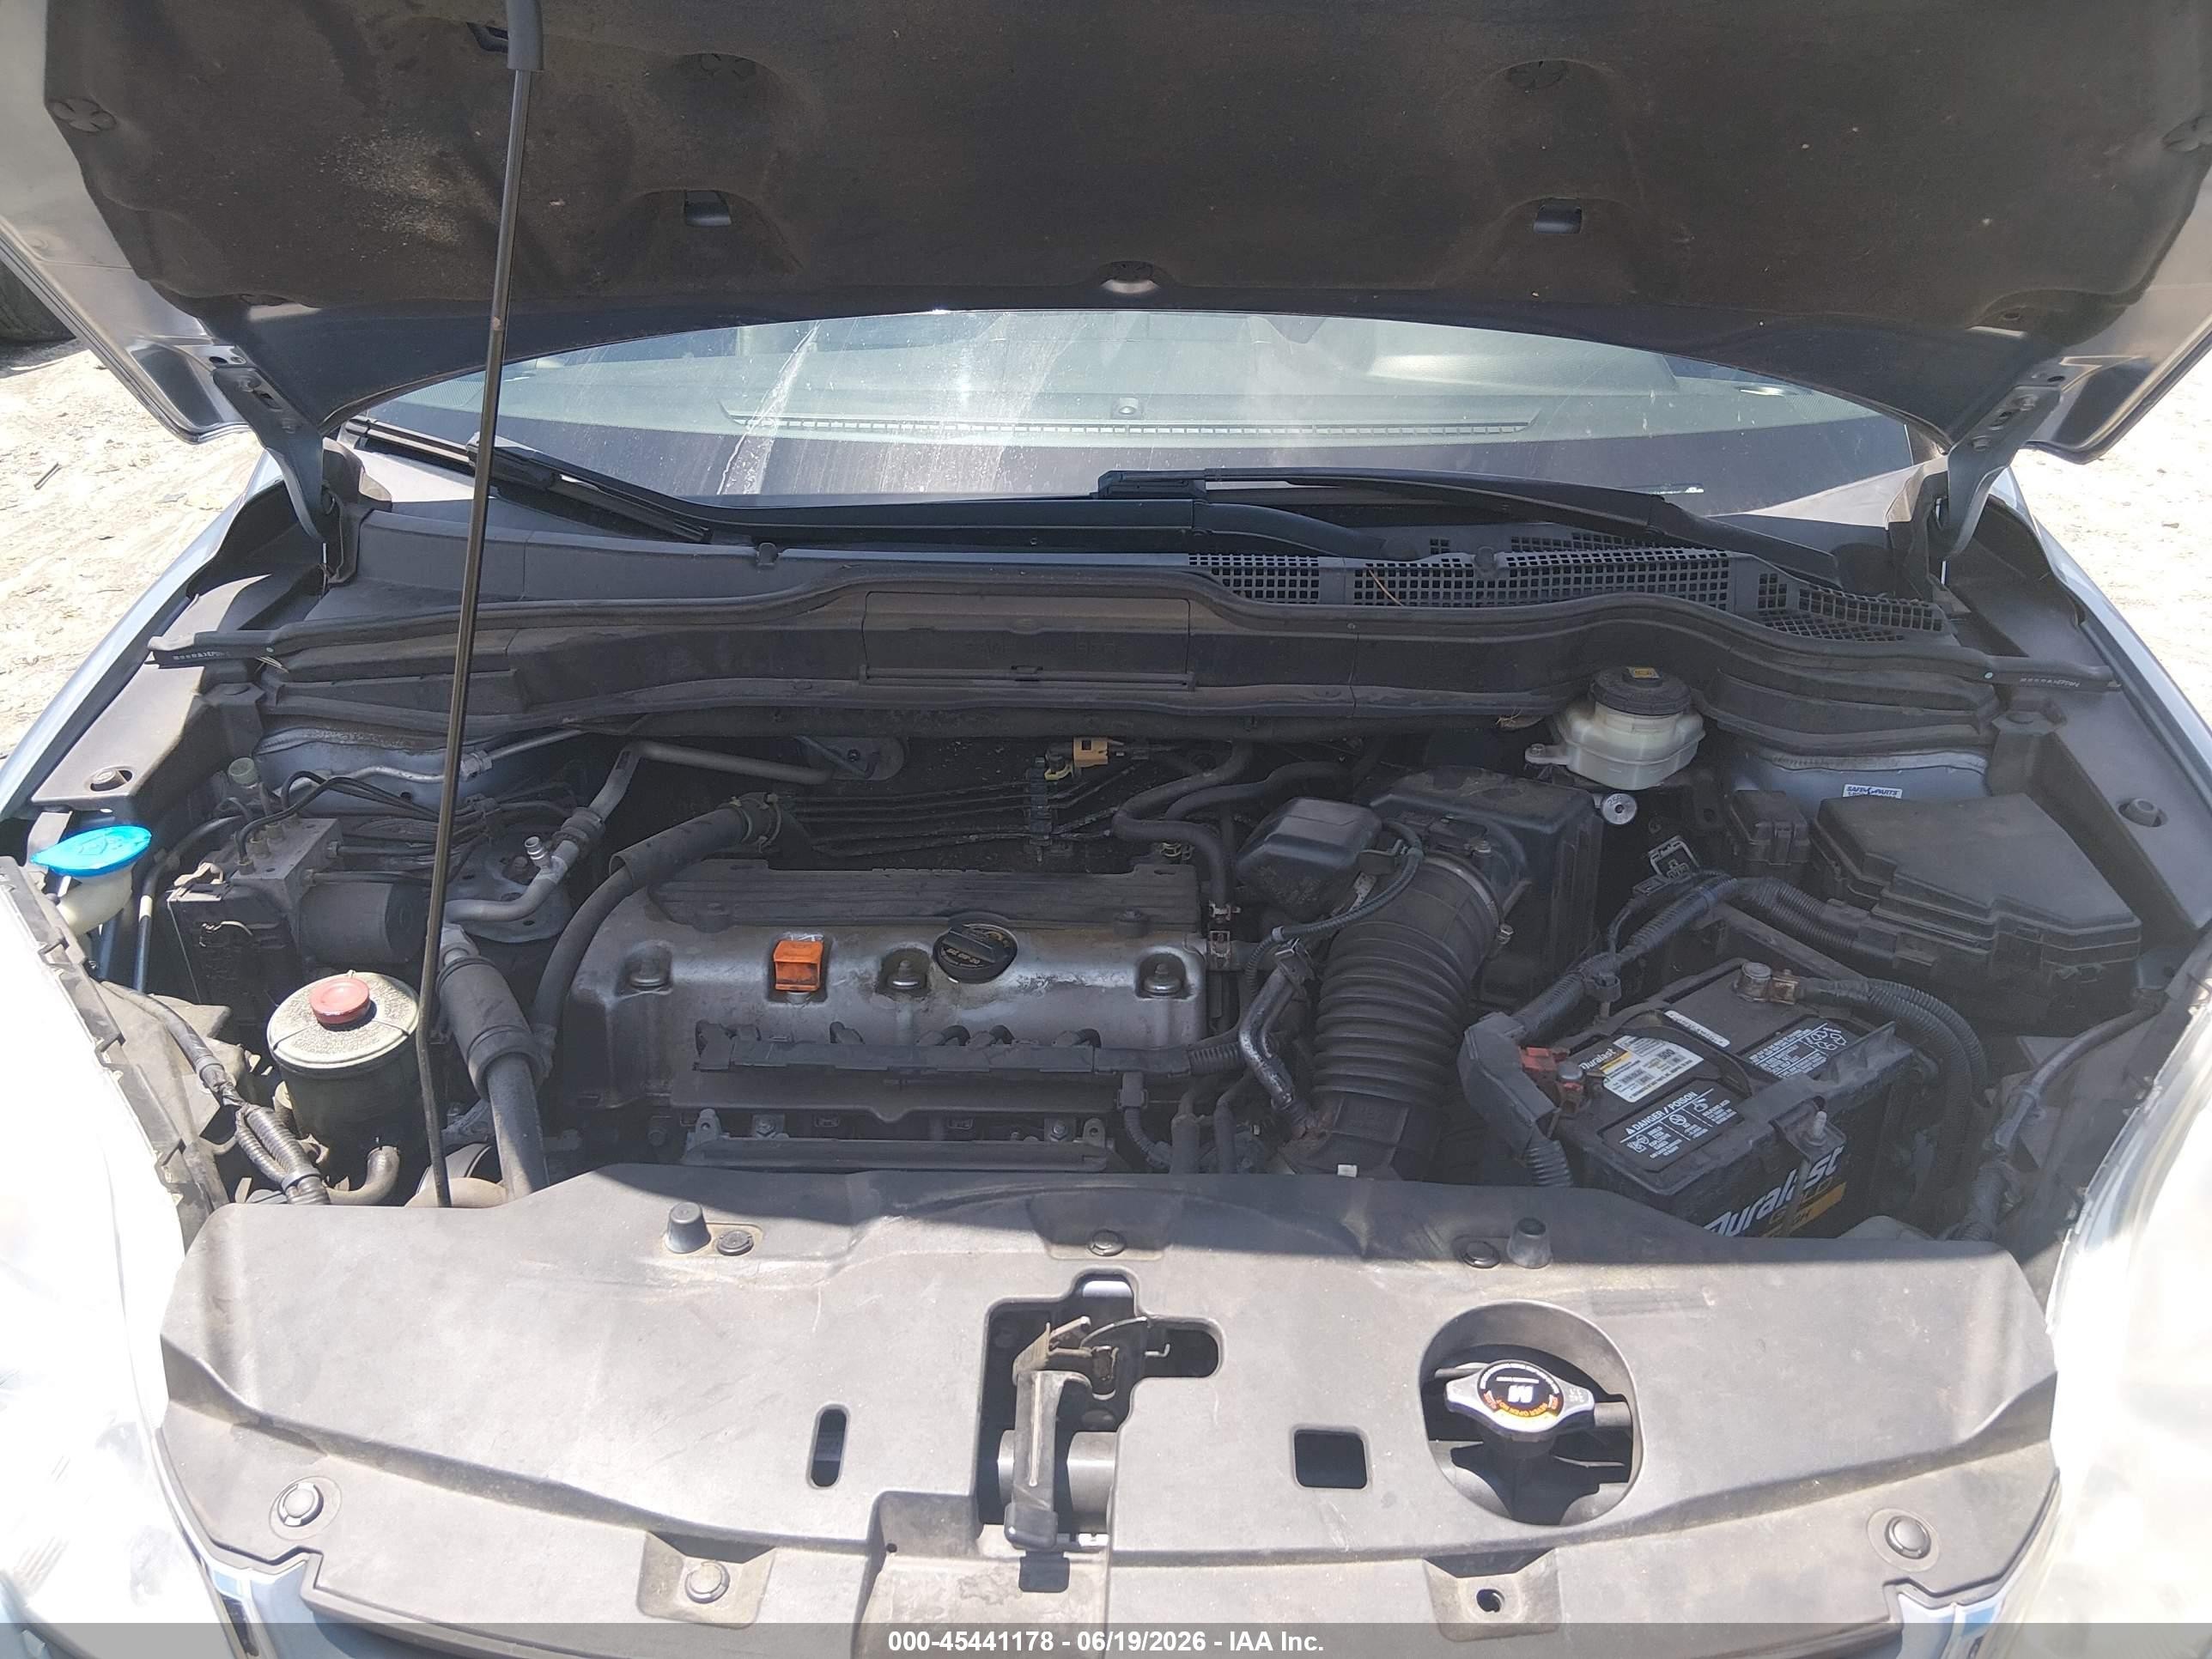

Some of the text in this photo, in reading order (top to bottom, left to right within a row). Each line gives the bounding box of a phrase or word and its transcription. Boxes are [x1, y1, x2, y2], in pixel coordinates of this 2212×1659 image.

[1578, 1048, 1616, 1070] Duralast
[1632, 1110, 1666, 1130] DANGER
[1668, 1091, 1698, 1110] POISON
